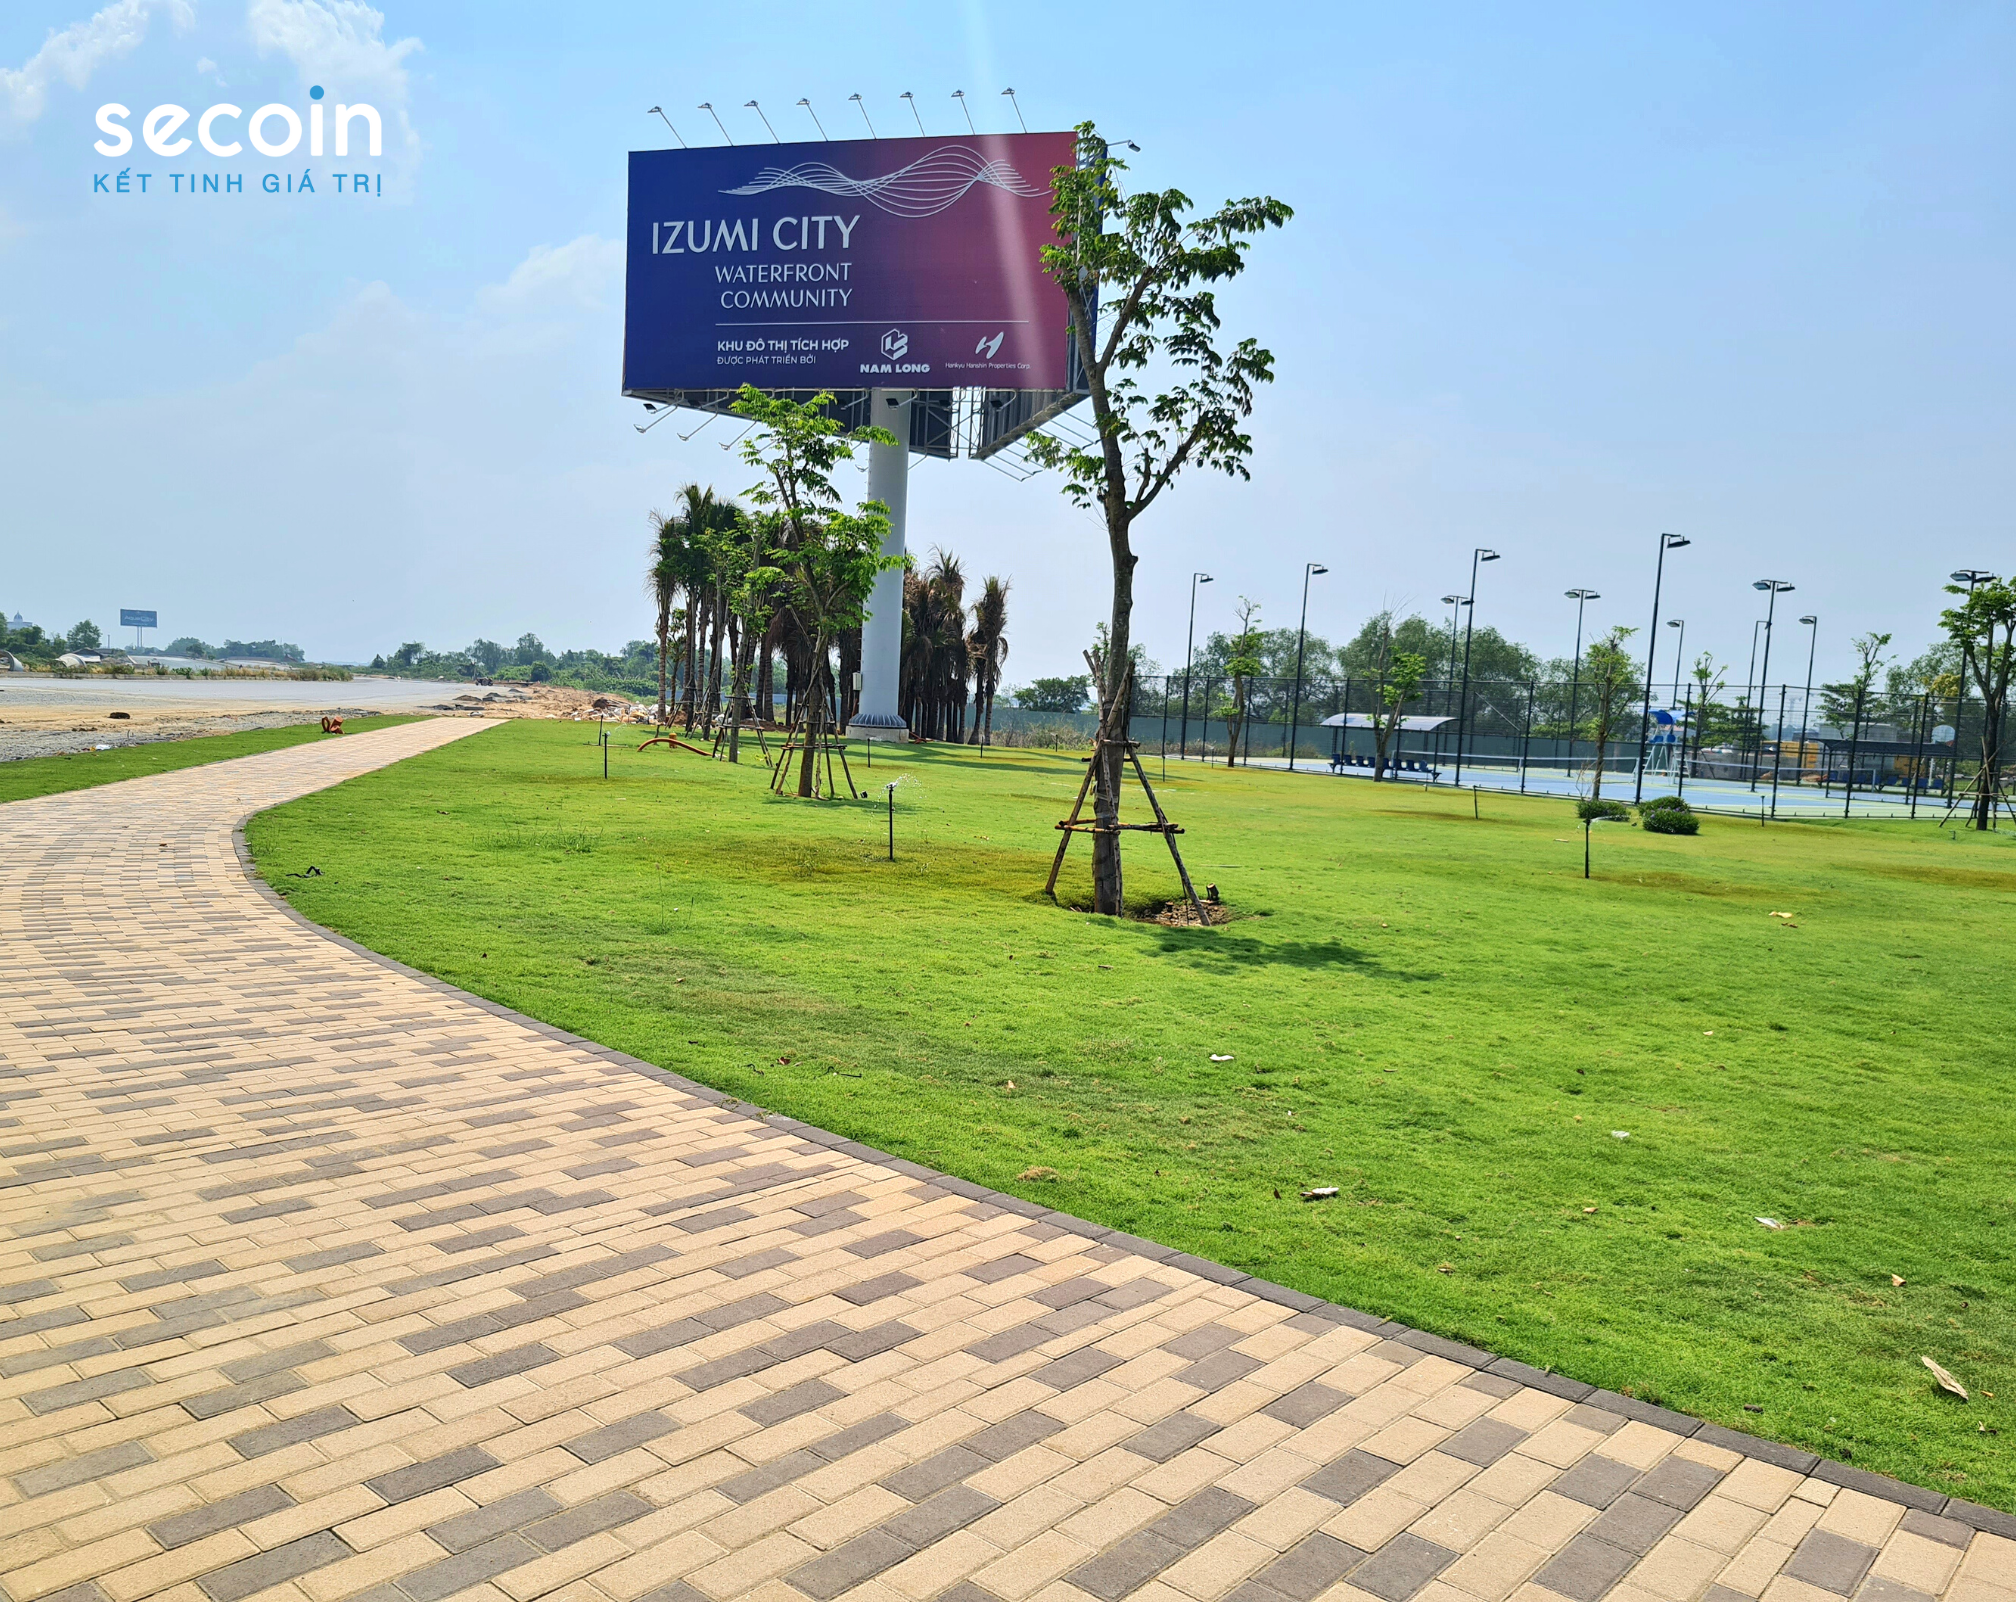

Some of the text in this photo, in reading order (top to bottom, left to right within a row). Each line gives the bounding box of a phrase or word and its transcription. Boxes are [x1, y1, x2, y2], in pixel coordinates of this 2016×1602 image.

[652, 215, 861, 255] IZUMI CITY
[715, 263, 852, 283] WATERFRONT
[721, 289, 852, 309] COMMUNITY
[717, 337, 849, 353] KHU ĐÔ THỊ TÍCH HỢP
[717, 355, 743, 366] ĐƯỢC
[746, 355, 769, 364] PHÁT
[860, 363, 930, 374] NAM LONG
